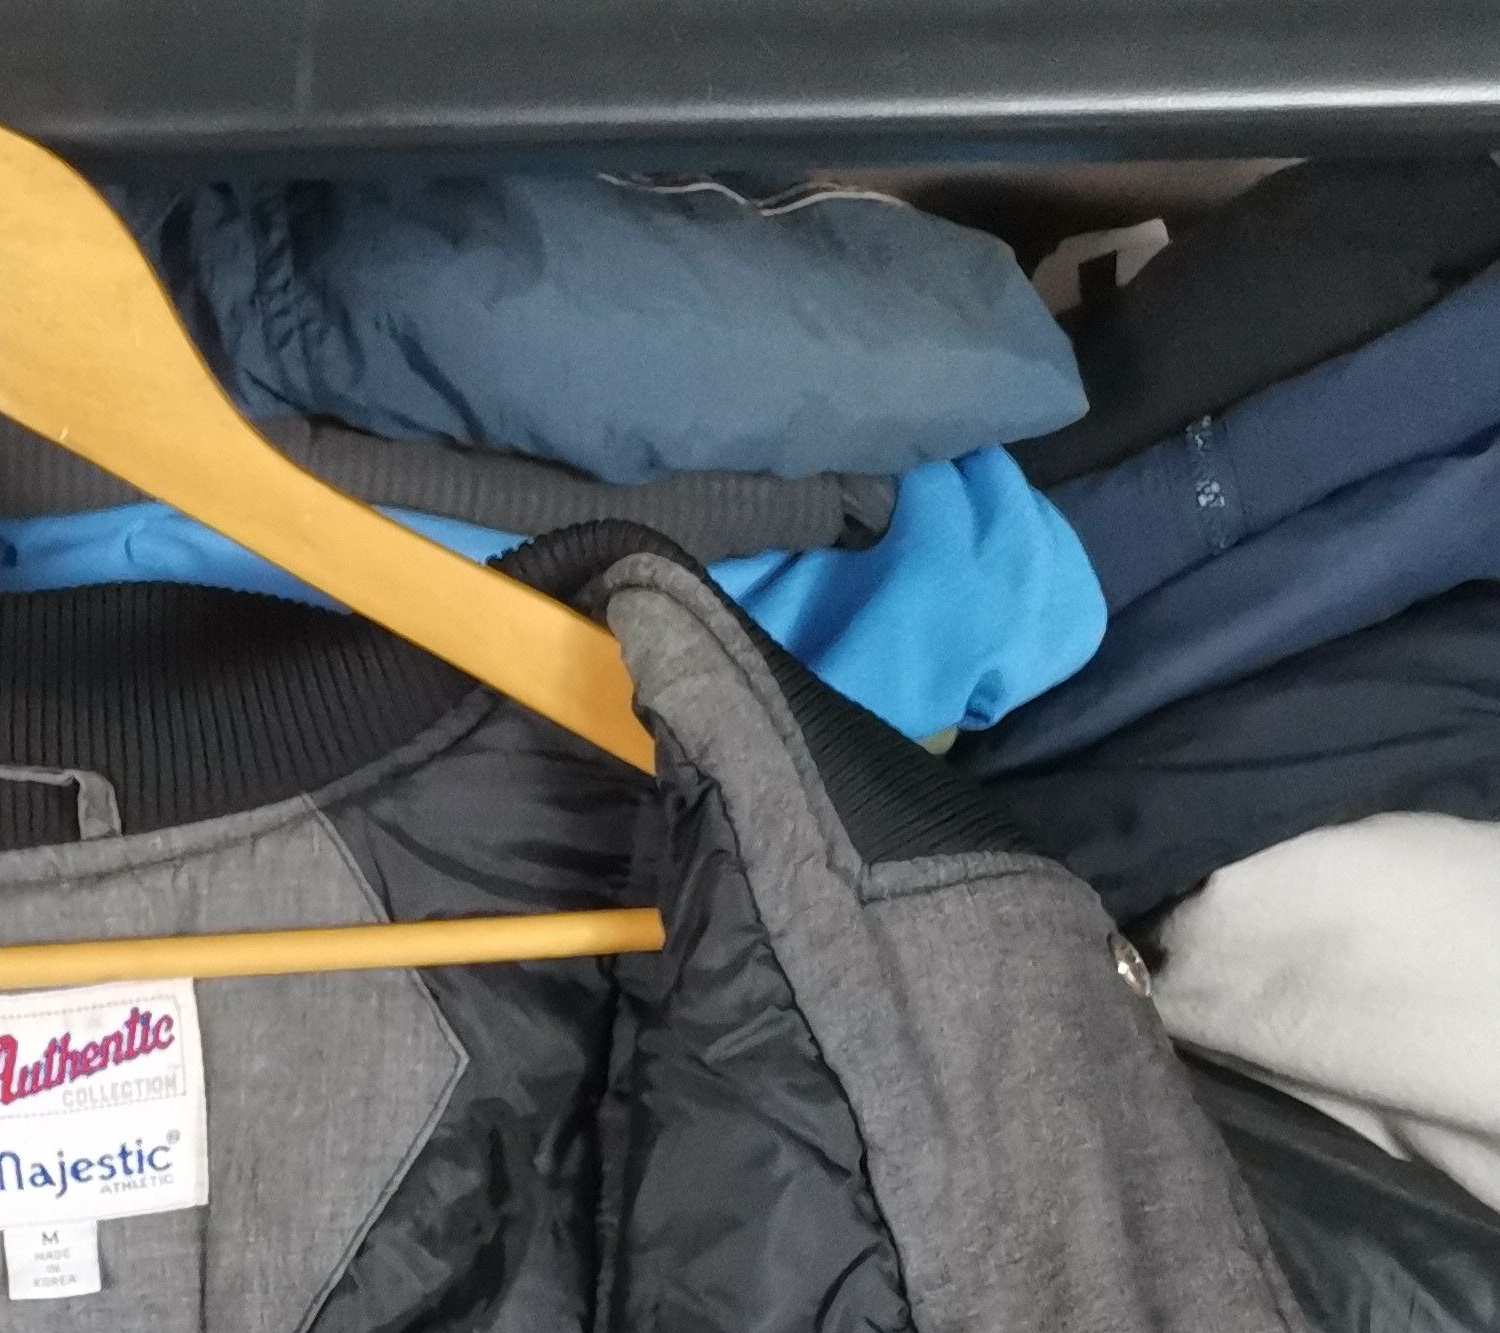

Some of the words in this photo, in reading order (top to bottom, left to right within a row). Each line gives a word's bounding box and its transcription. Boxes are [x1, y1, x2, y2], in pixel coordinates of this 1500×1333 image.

[62, 1074, 177, 1107] COLLECTION
[100, 1173, 174, 1195] ATHLETIC
[41, 1230, 60, 1246] M
